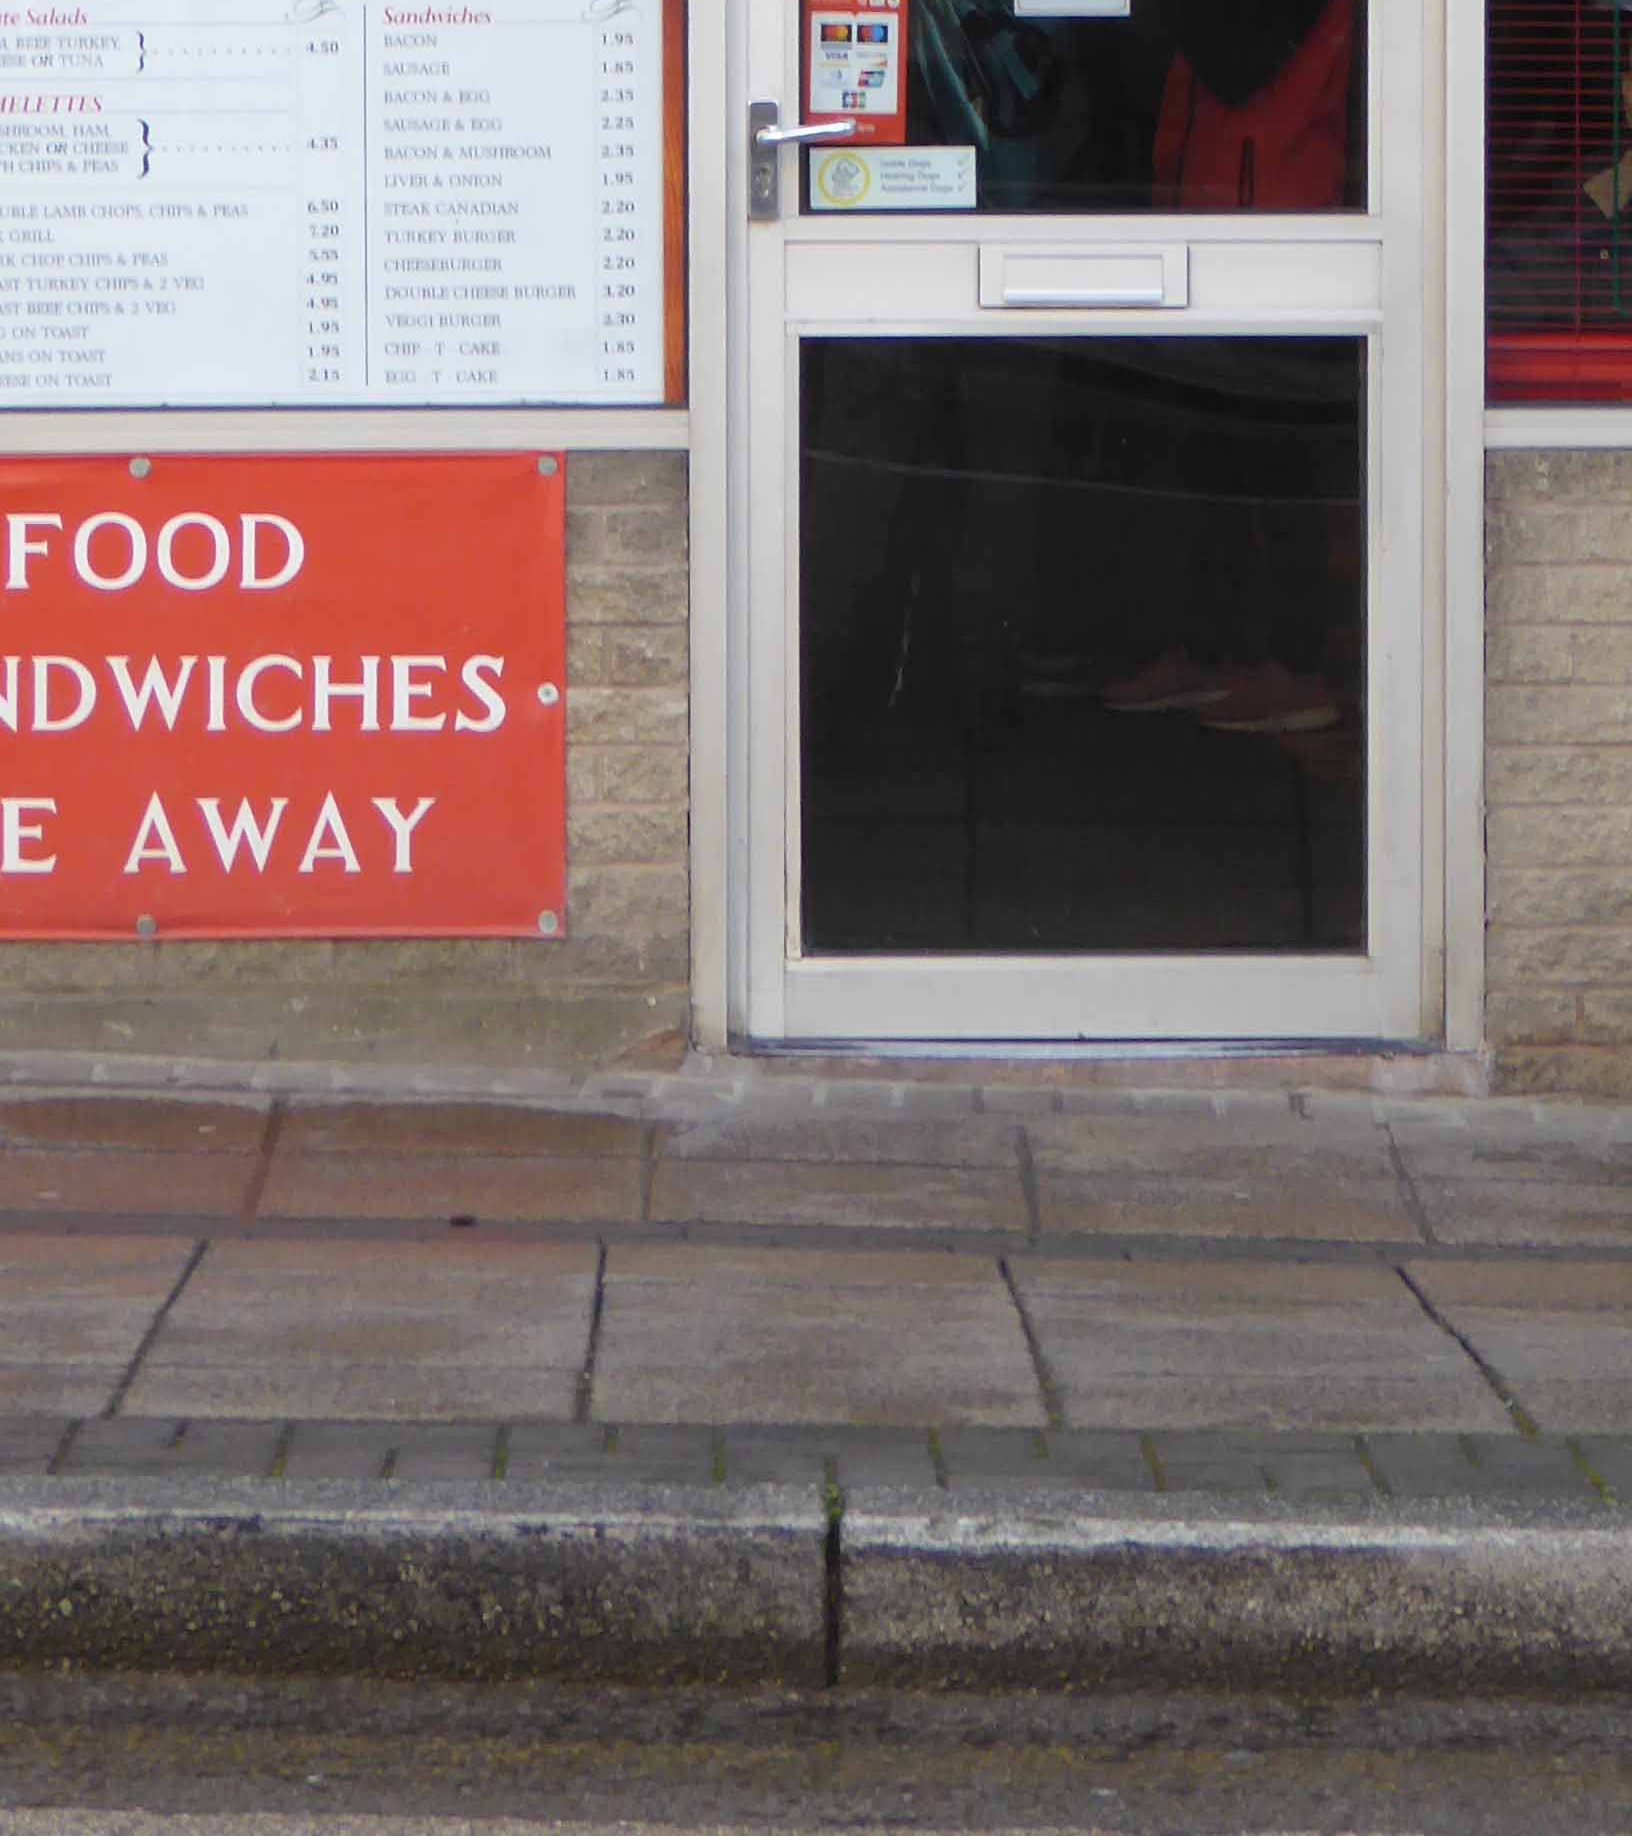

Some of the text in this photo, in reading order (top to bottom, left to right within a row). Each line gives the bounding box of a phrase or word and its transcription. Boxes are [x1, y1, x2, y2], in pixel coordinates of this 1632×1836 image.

[25, 8, 88, 25] Salads
[383, 5, 492, 24] Sandwiches
[384, 35, 437, 48] BACON
[602, 34, 634, 46] 1.95
[383, 62, 450, 76] SAUSAGE
[384, 91, 437, 104] BACON
[383, 118, 450, 132] SAUSAGE
[384, 146, 437, 159] BACON
[459, 146, 552, 159] MUSHROOM
[385, 174, 428, 188] LIVER
[449, 174, 503, 188] ONION
[383, 202, 519, 215] STEAK CANADIAN
[602, 201, 635, 213] 2.20
[385, 230, 516, 244] TURKEY BURGER
[385, 285, 449, 300] DOUBLE
[514, 285, 576, 300] BURGER
[439, 314, 502, 328] BURGER
[459, 342, 501, 356] CAKE
[456, 370, 498, 384] CAKE
[6, 511, 305, 591] FOOD
[124, 791, 436, 874] AWAY
